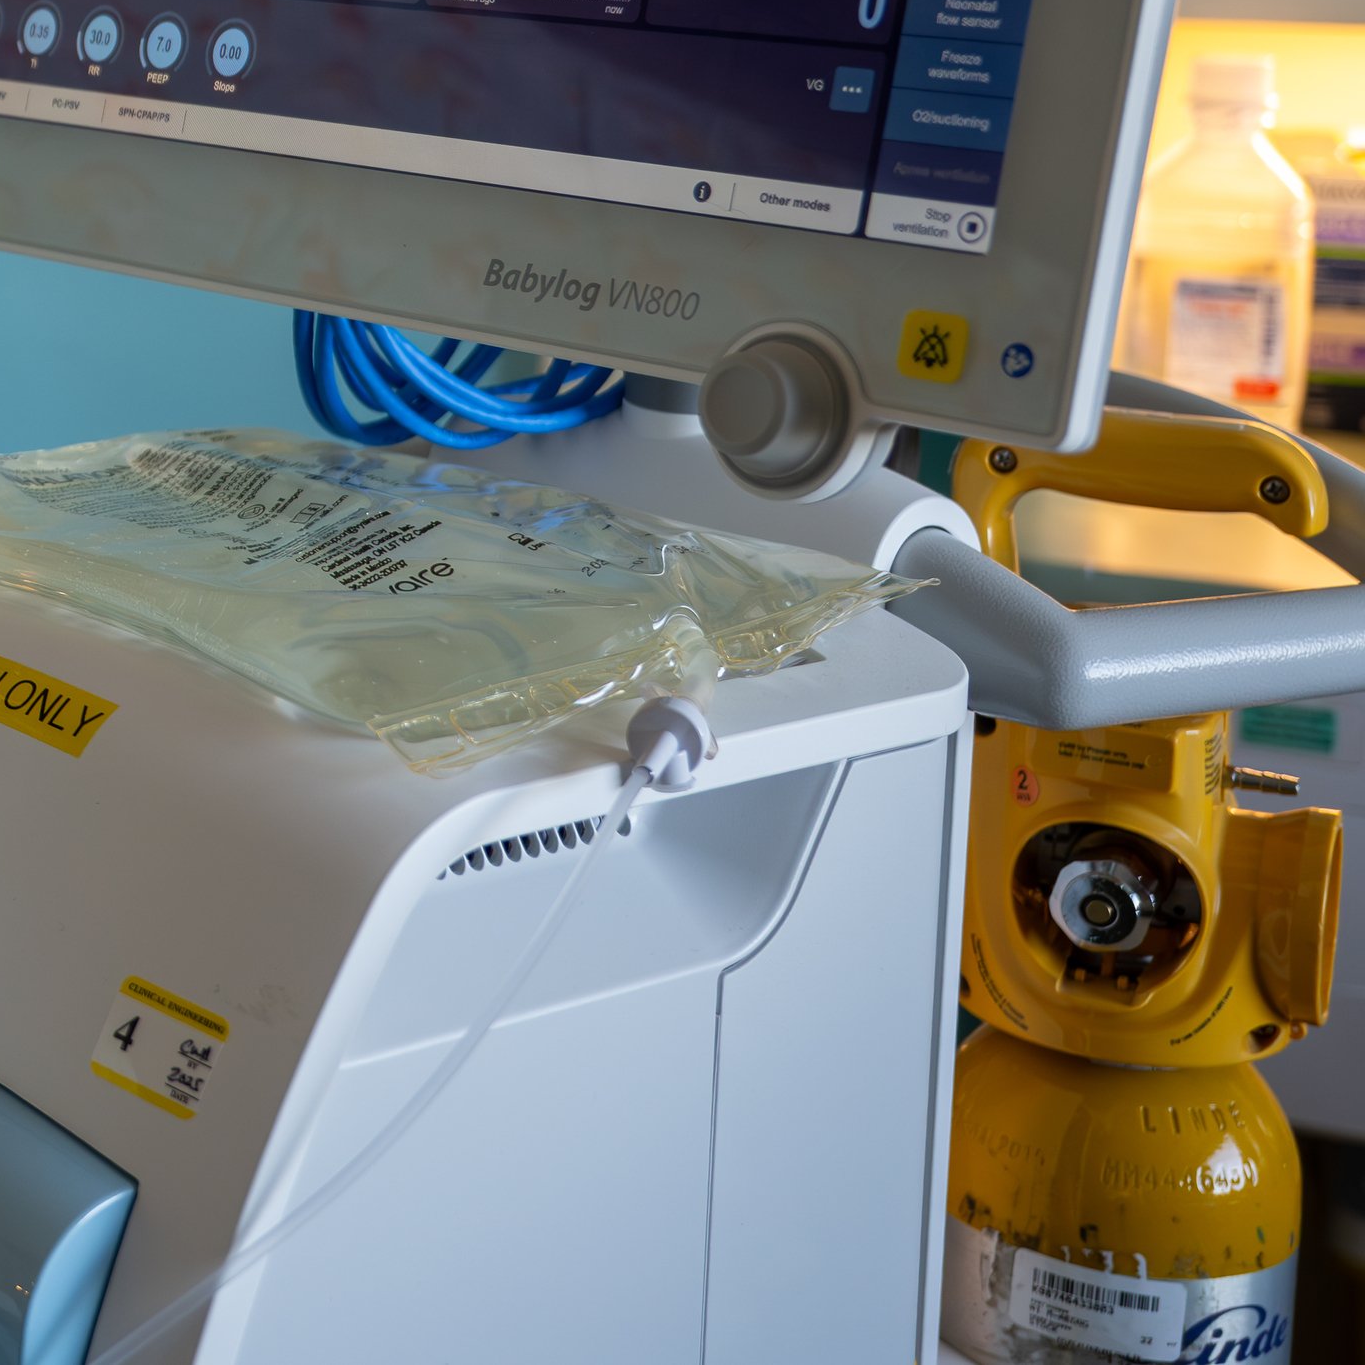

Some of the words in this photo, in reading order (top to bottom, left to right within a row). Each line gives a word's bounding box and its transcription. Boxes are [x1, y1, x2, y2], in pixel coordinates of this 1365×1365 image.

[605, 5, 623, 15] now
[961, 16, 1002, 29] sensor
[89, 30, 111, 46] 30.0
[157, 36, 172, 52] 7.0
[219, 43, 241, 60] 0.00
[88, 65, 101, 76] RR
[146, 72, 169, 84] PEEP
[213, 81, 235, 93] Slope
[806, 79, 824, 91] VG
[759, 192, 790, 208] Other
[793, 198, 831, 212] modes
[925, 207, 951, 223] Stop
[483, 258, 601, 311] Babylog
[608, 278, 700, 321] VN800
[4, 679, 104, 737] ONLY
[1014, 769, 1029, 790] 2
[113, 1015, 140, 1051] 4
